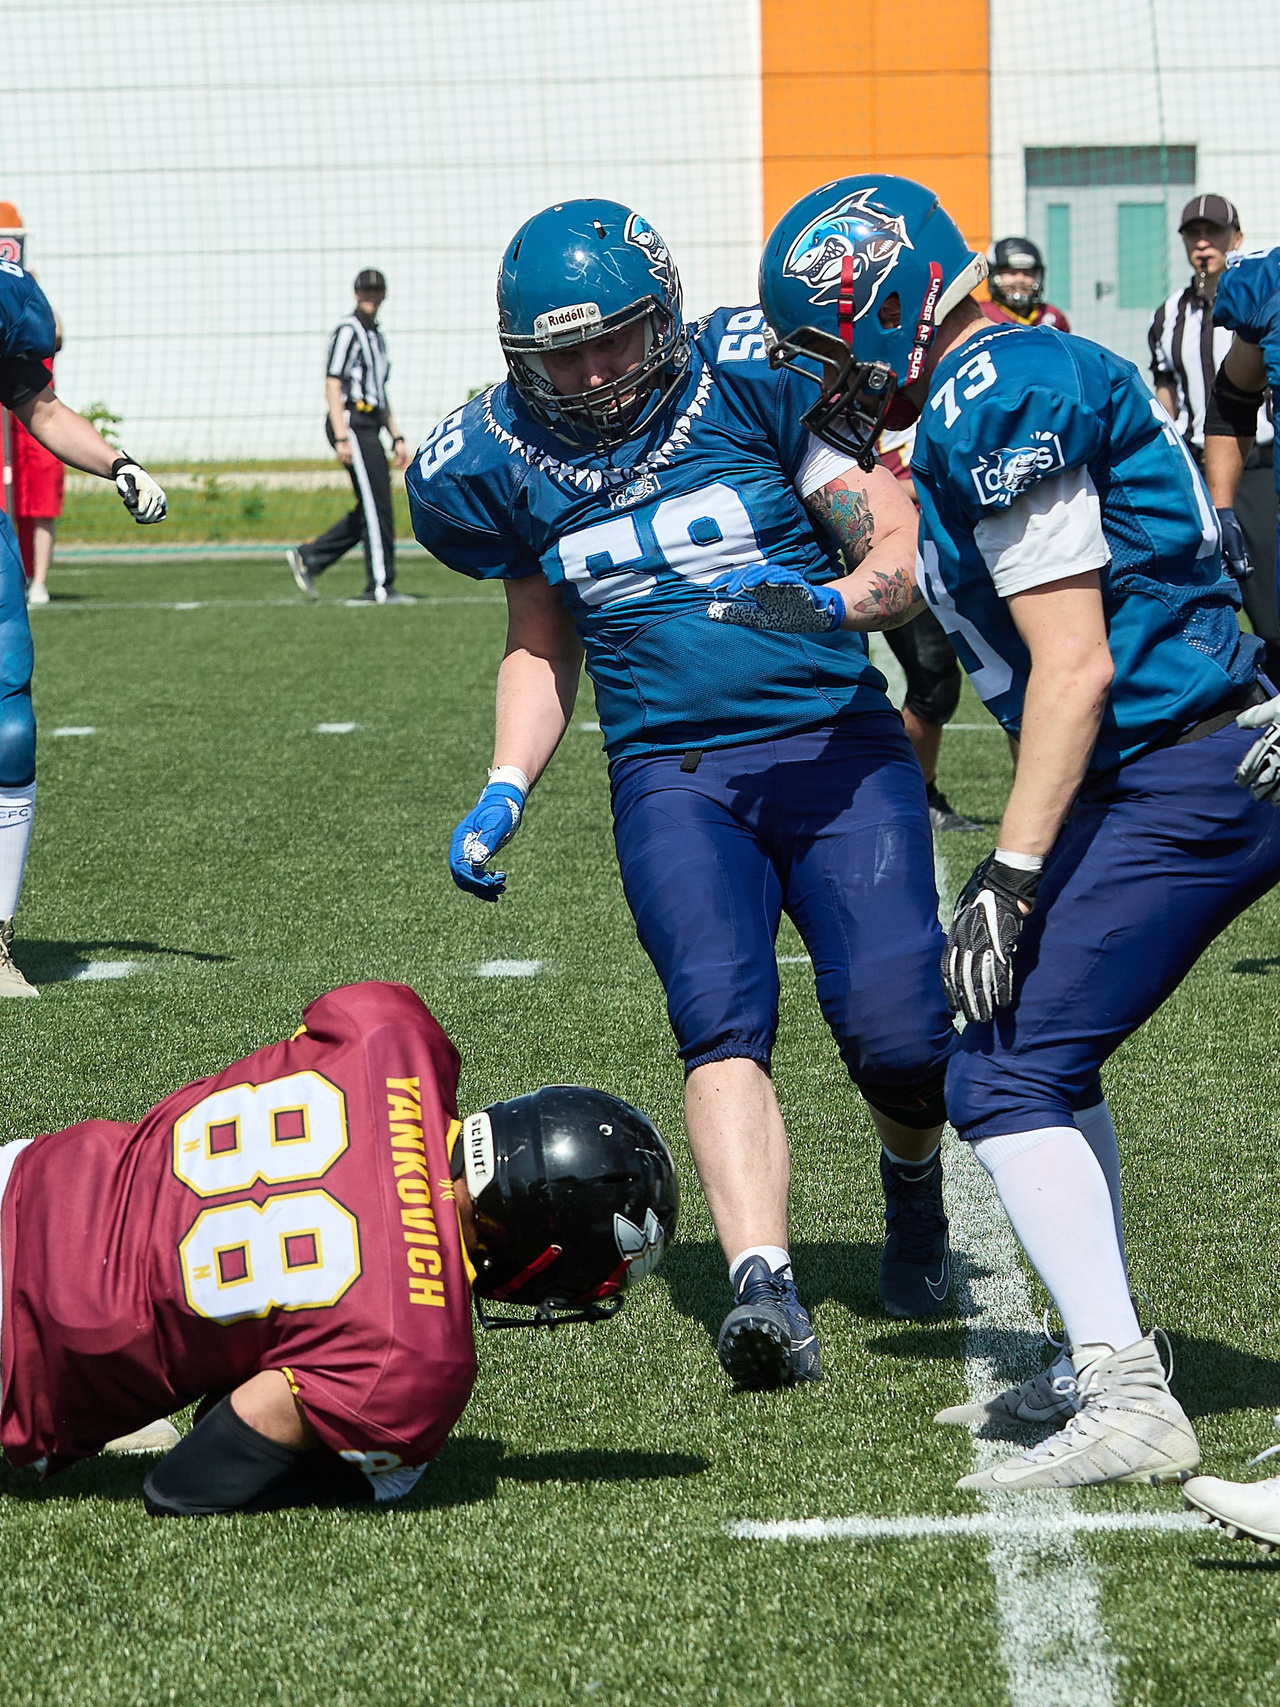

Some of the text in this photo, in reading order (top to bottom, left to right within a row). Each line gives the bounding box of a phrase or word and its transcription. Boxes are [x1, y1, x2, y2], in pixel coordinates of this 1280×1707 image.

[549, 308, 585, 328] Riddell
[716, 308, 768, 365] 59
[923, 278, 941, 320] UNDER
[930, 350, 998, 429] 73
[419, 406, 466, 481] 59
[172, 1069, 362, 1326] 88
[385, 1075, 446, 1307] YANKOVICH
